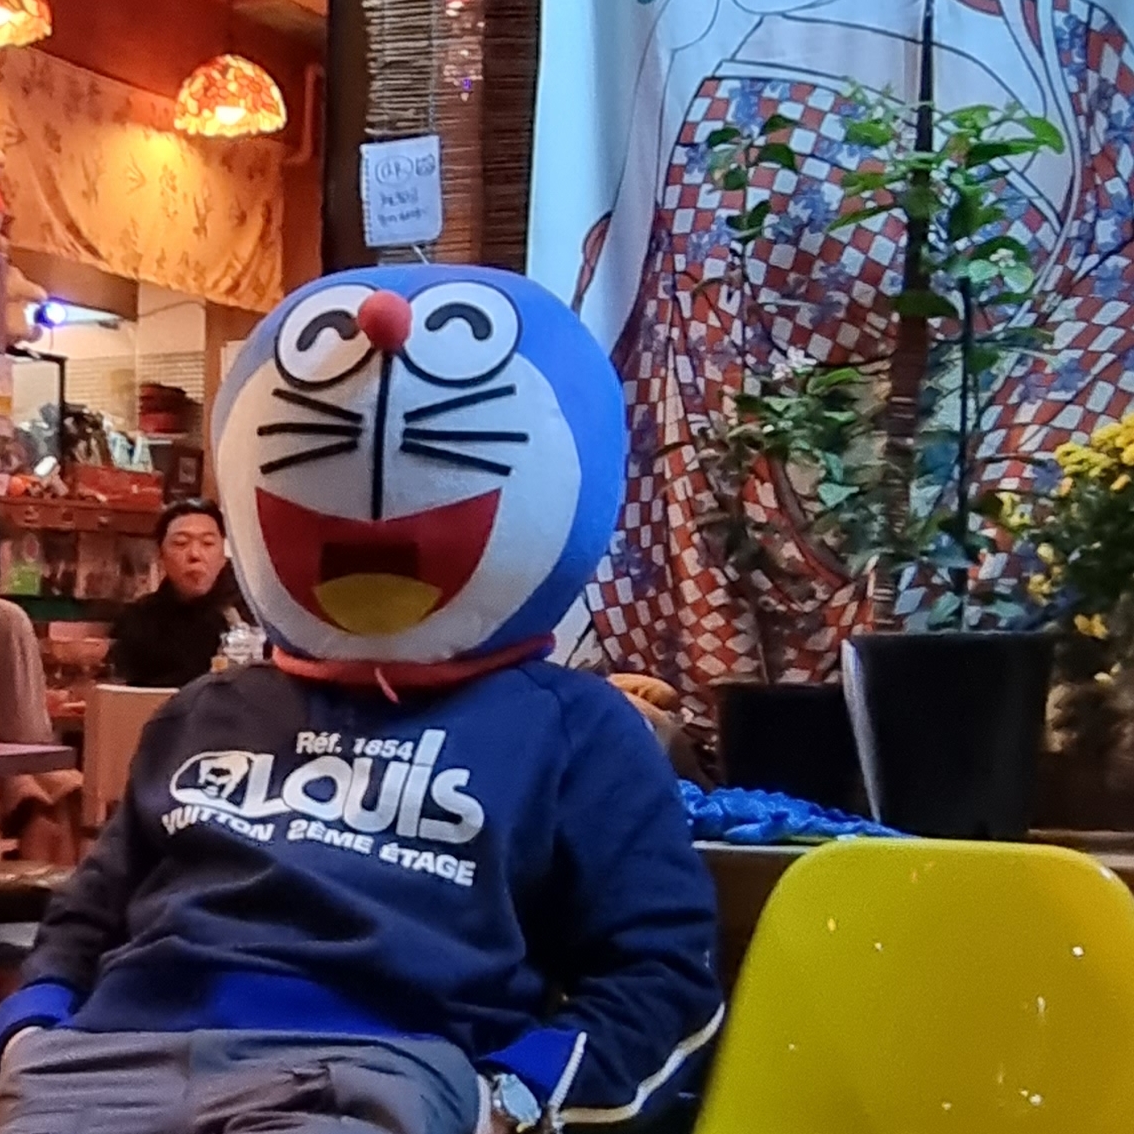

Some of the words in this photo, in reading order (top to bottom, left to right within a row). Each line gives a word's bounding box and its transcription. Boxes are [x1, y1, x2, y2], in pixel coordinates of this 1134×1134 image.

[296, 731, 342, 754] Réf.
[353, 738, 414, 762] 1854
[161, 804, 275, 842] VUITTON
[286, 819, 374, 854] 2ÈME
[379, 842, 477, 887] ÉTAGE
